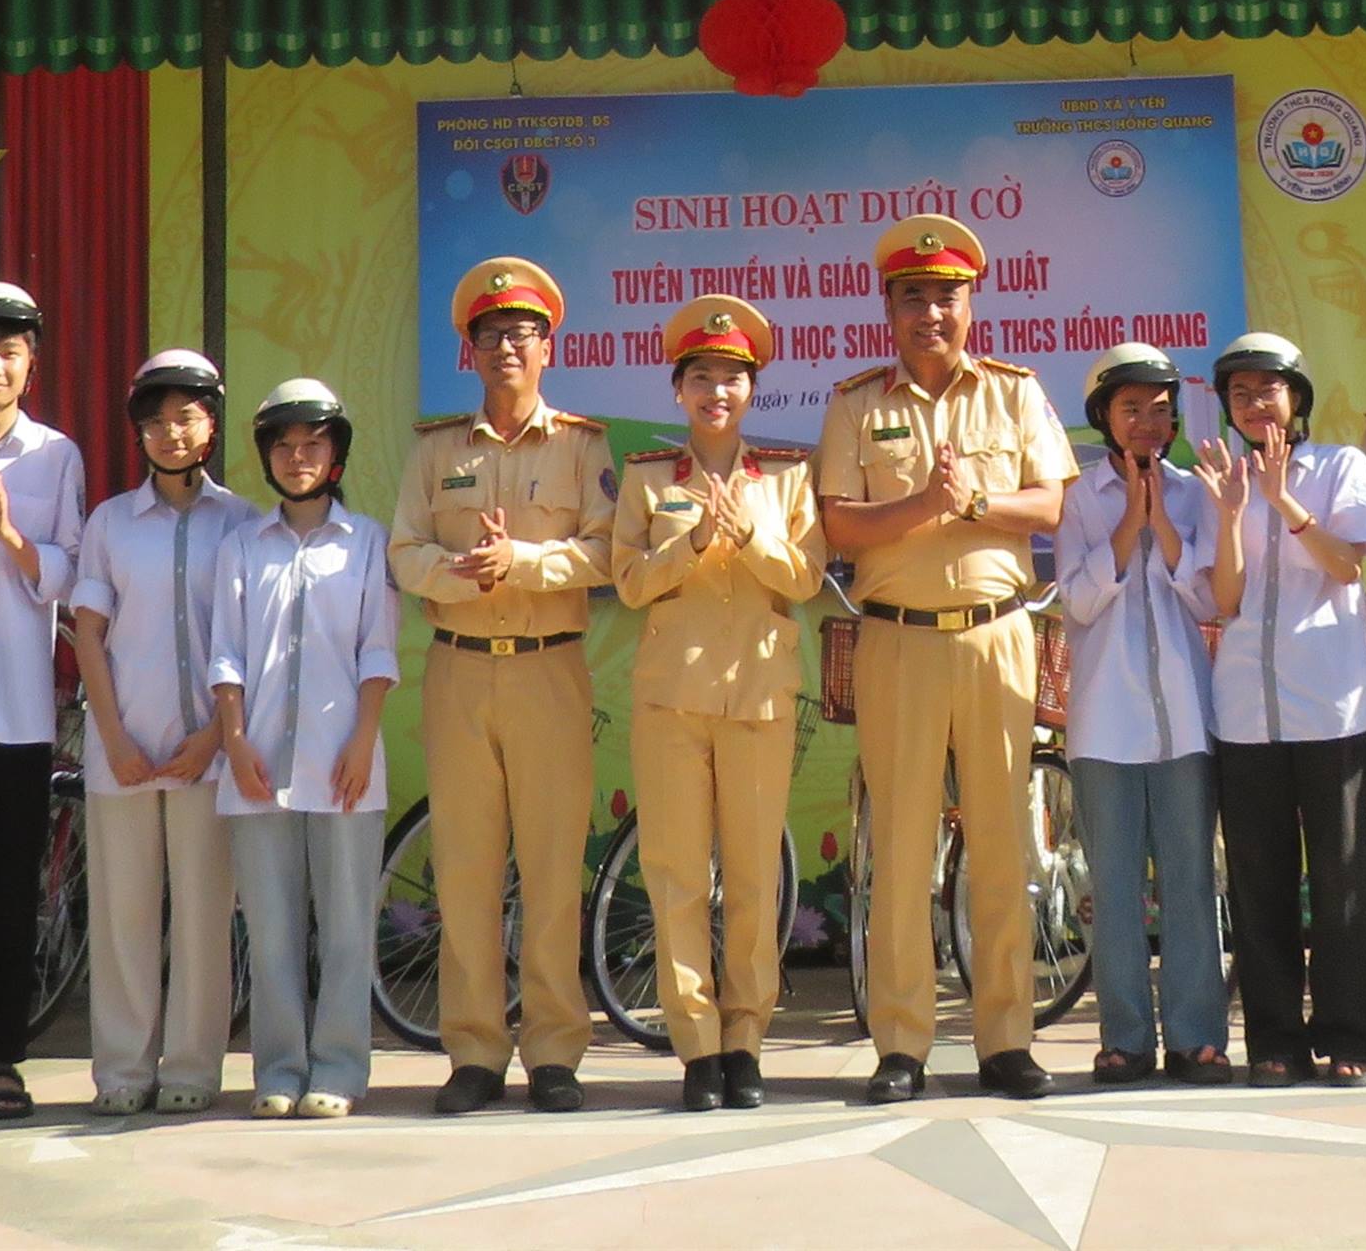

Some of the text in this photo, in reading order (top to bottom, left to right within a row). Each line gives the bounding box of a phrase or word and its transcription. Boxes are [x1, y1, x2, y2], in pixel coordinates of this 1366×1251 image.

[1061, 99, 1100, 114] UBND
[437, 116, 489, 132] PHÒNG
[492, 117, 513, 130] HD
[1015, 116, 1073, 135] TRƯỜNG
[1076, 118, 1113, 133] THCS
[1161, 114, 1214, 129] QUANG
[1342, 111, 1363, 147] QUANG
[484, 136, 520, 151] CSGT
[564, 132, 583, 148] SỐ
[588, 135, 597, 148] 3
[635, 174, 1023, 234] SINH HOẠT DƯỚI CỜ
[611, 260, 684, 305] TUYÊN
[782, 256, 812, 299] VÀ
[818, 255, 871, 298] GIÁO
[996, 250, 1050, 299] LUẬT
[563, 331, 616, 368] GIAO
[622, 322, 675, 365] THÔ
[791, 324, 836, 368] HỌC
[843, 323, 898, 359] SINH
[999, 317, 1057, 354] THCS
[1132, 312, 1208, 349] QUANG
[750, 389, 793, 412] ngày
[799, 390, 820, 407] 16
